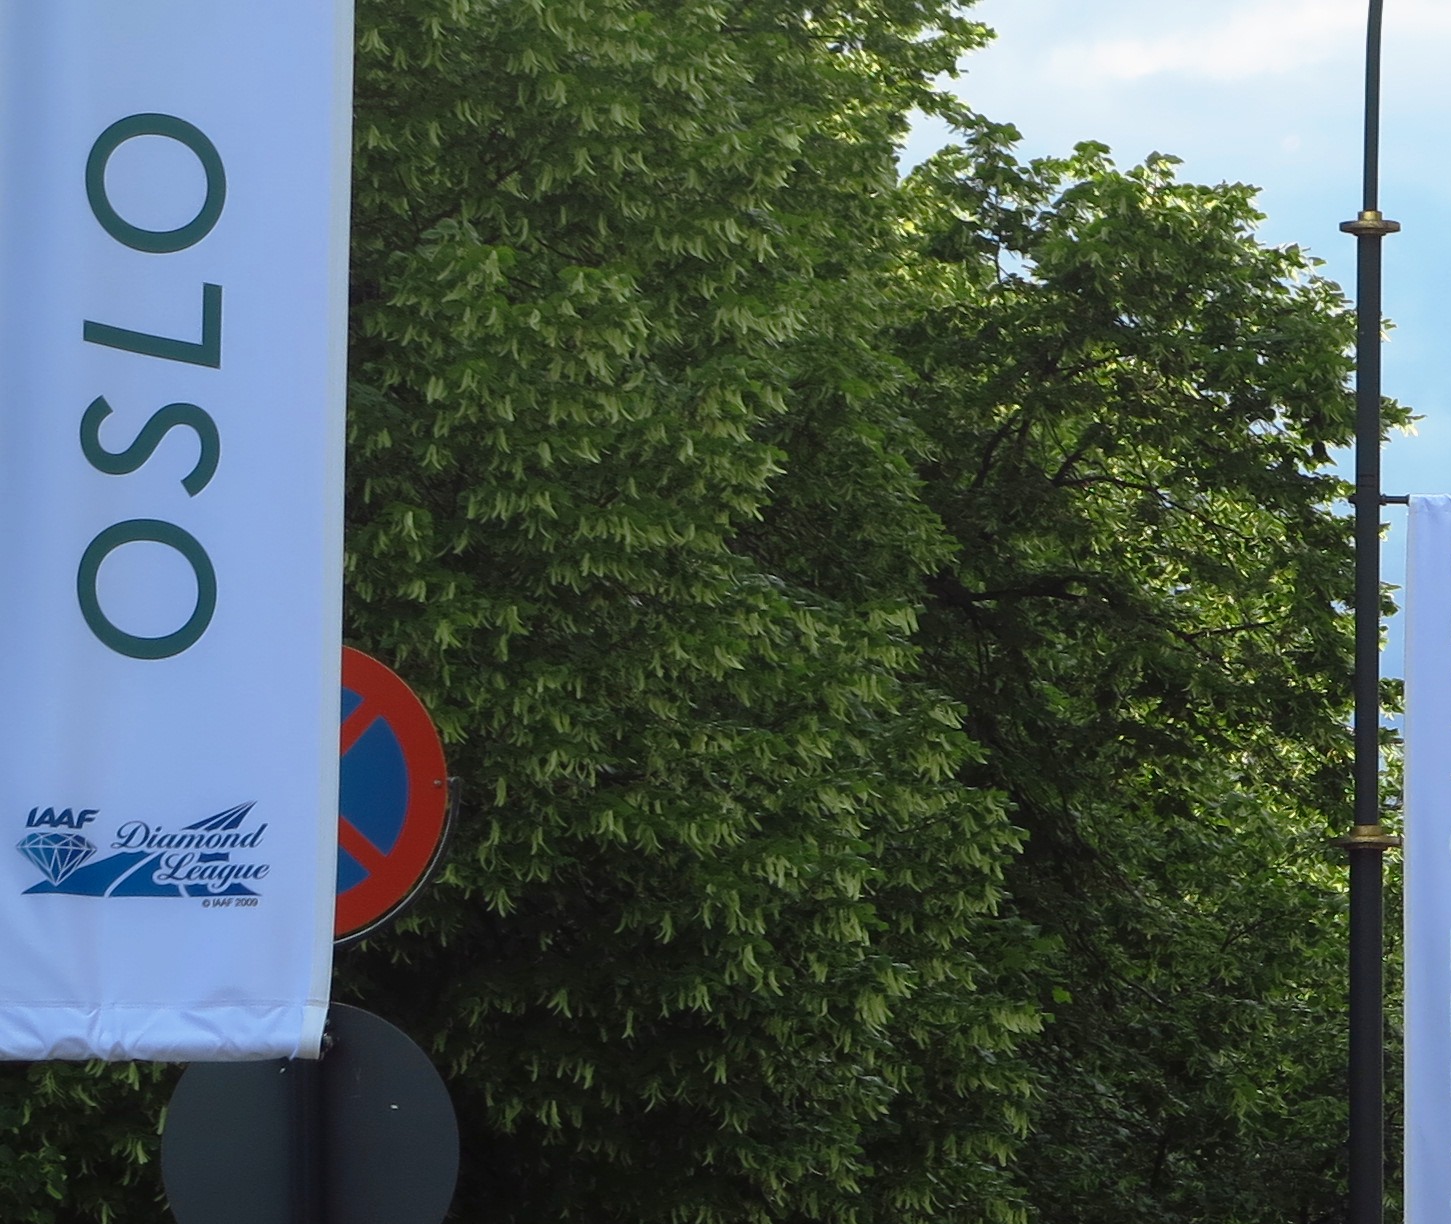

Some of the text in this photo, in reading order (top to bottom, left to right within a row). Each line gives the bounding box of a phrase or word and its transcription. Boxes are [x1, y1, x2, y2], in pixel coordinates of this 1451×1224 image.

[77, 112, 227, 660] OSLO
[25, 806, 99, 829] IAAF
[110, 821, 268, 849] Diamond
[157, 851, 270, 888] League
[212, 898, 234, 907] IAAF
